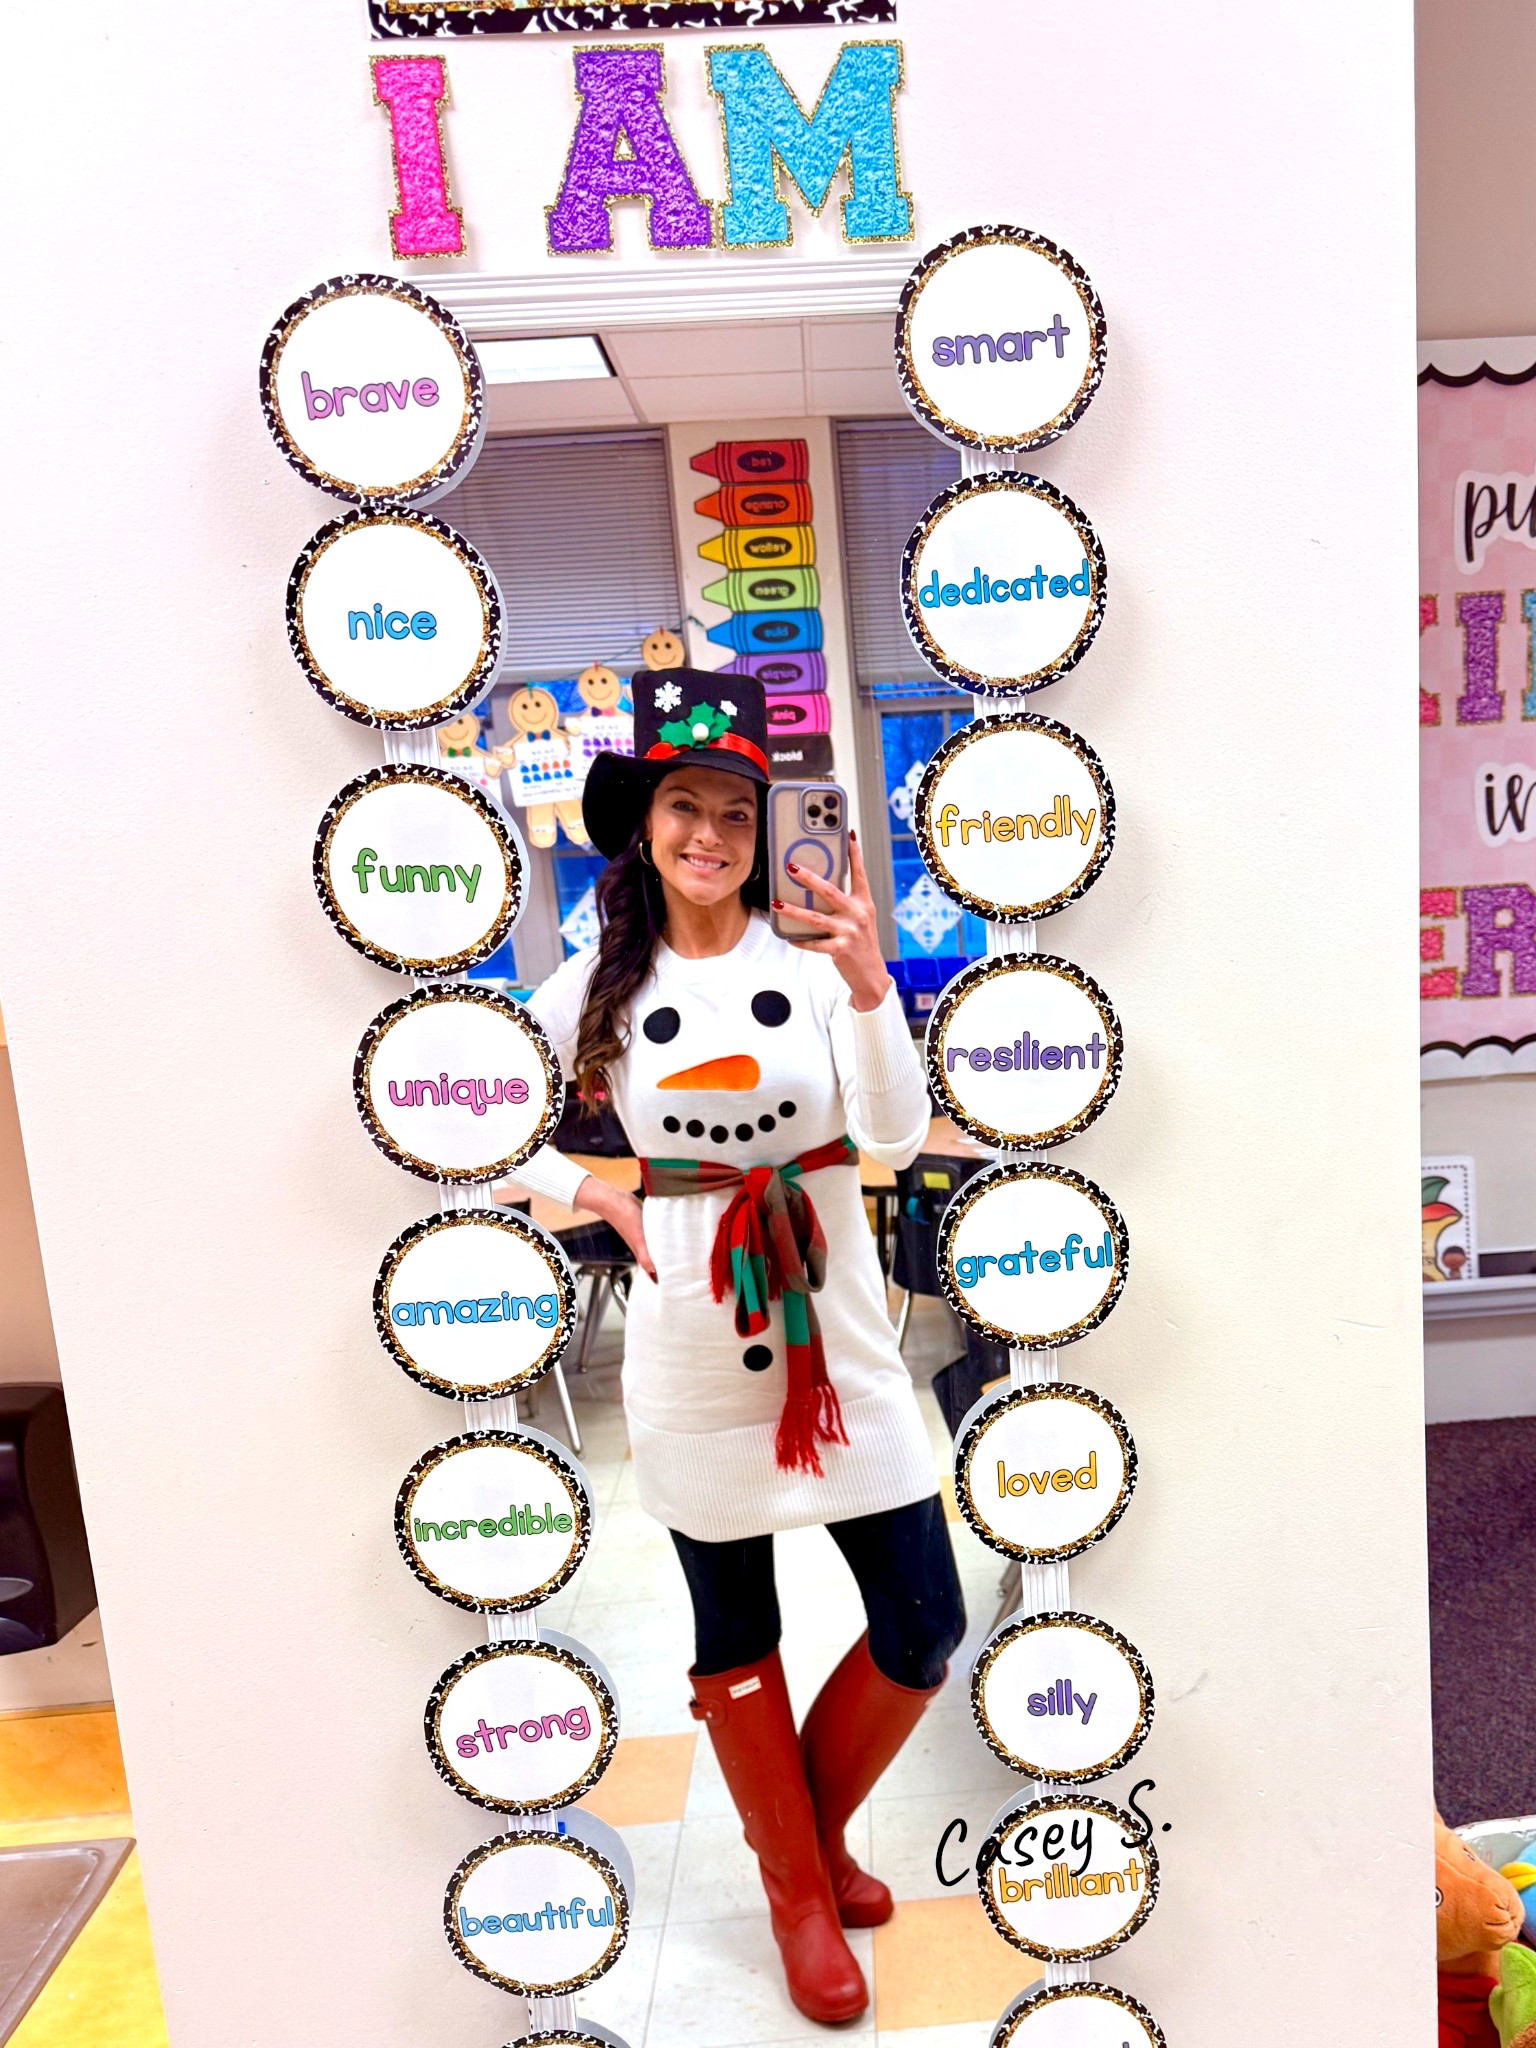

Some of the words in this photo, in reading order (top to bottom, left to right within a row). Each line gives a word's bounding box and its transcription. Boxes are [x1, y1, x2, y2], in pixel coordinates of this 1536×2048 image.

[368, 54, 468, 260] I
[544, 38, 916, 256] AM
[932, 314, 1070, 367] smart
[301, 371, 439, 421] brave
[919, 558, 1090, 608] dedicated
[348, 603, 437, 640] nice
[935, 795, 1096, 847] friendly
[352, 848, 482, 903] funny
[947, 1031, 1105, 1072] resilient
[388, 1073, 529, 1116] unique
[956, 1231, 1113, 1288] grateful
[392, 1291, 559, 1328] amazing
[997, 1451, 1097, 1498] loved
[414, 1502, 572, 1542] incredible
[1027, 1679, 1097, 1725] silly
[456, 1706, 591, 1758] strong
[998, 1858, 1144, 1904] brilliant
[459, 1896, 614, 1937] beautiful
